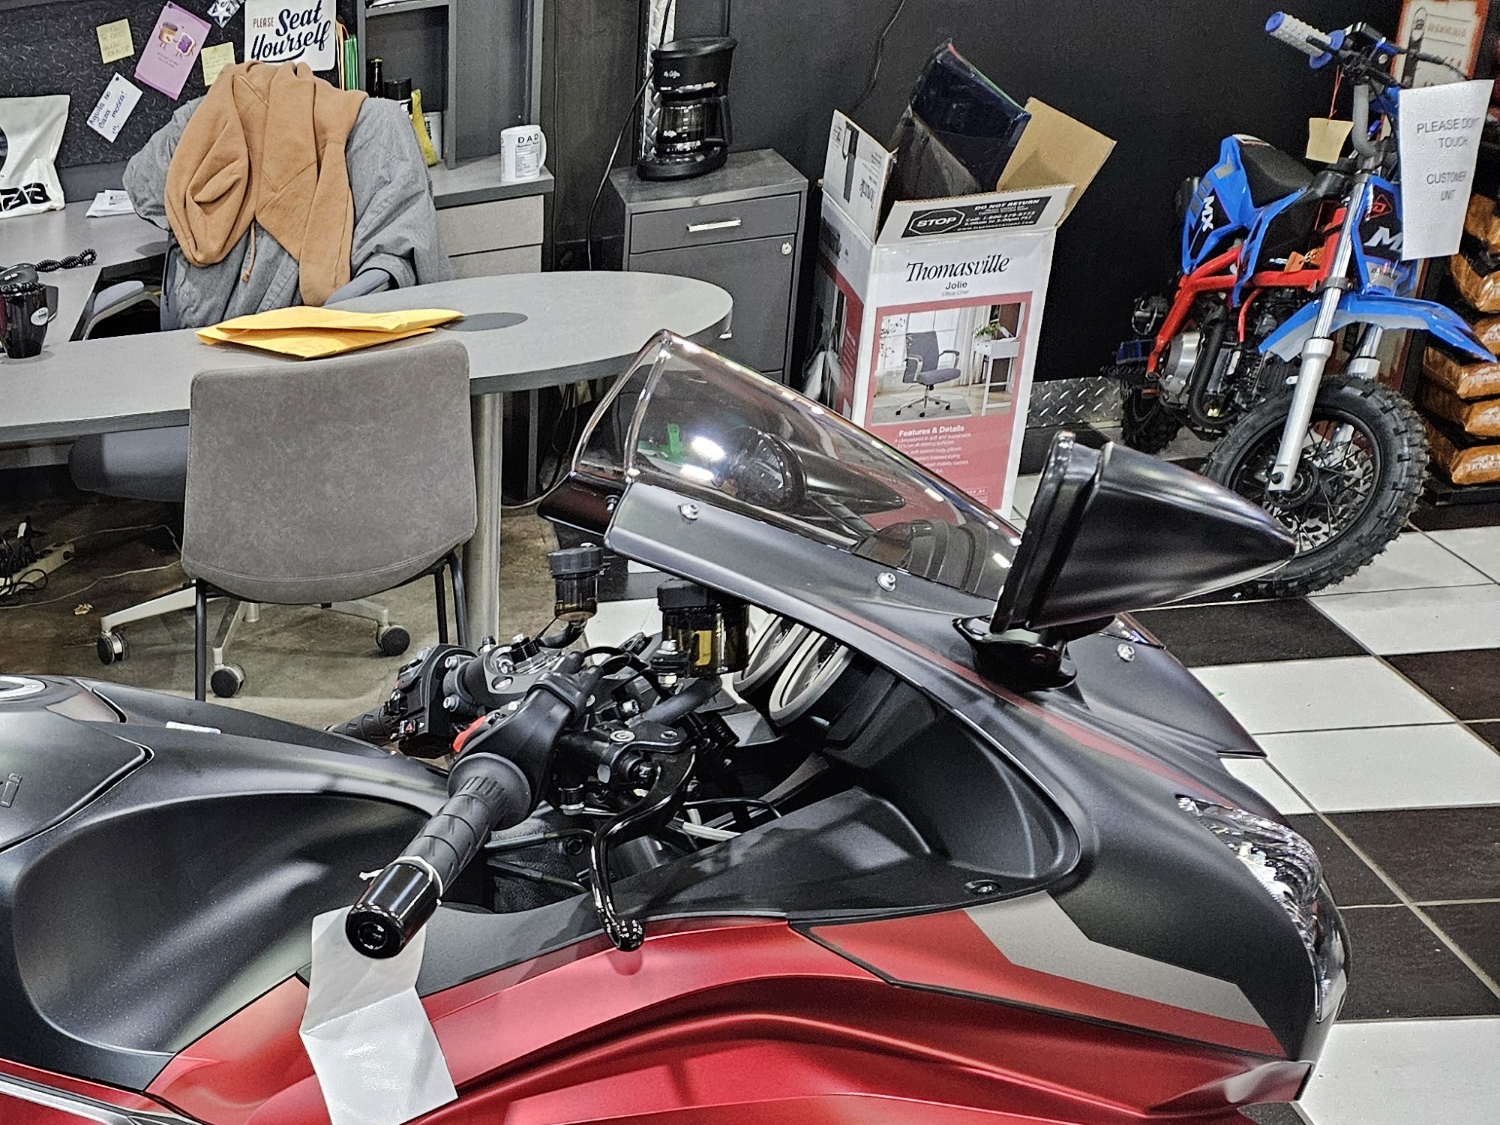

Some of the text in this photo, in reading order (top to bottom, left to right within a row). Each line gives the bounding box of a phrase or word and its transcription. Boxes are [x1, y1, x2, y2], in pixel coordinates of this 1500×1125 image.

[252, 0, 323, 37] PLEASE Seat
[250, 20, 332, 61] Yourself
[1416, 118, 1460, 134] PLEASE
[1438, 136, 1469, 149] TOUCH
[1426, 171, 1467, 185] CUSTOMER
[1006, 199, 1040, 208] RETURN
[1202, 195, 1215, 233] MX
[916, 217, 957, 228] STOP
[906, 253, 1010, 283] Thomasville
[945, 281, 968, 290] Jolie
[899, 429, 931, 437] Features
[939, 425, 965, 433] Details
